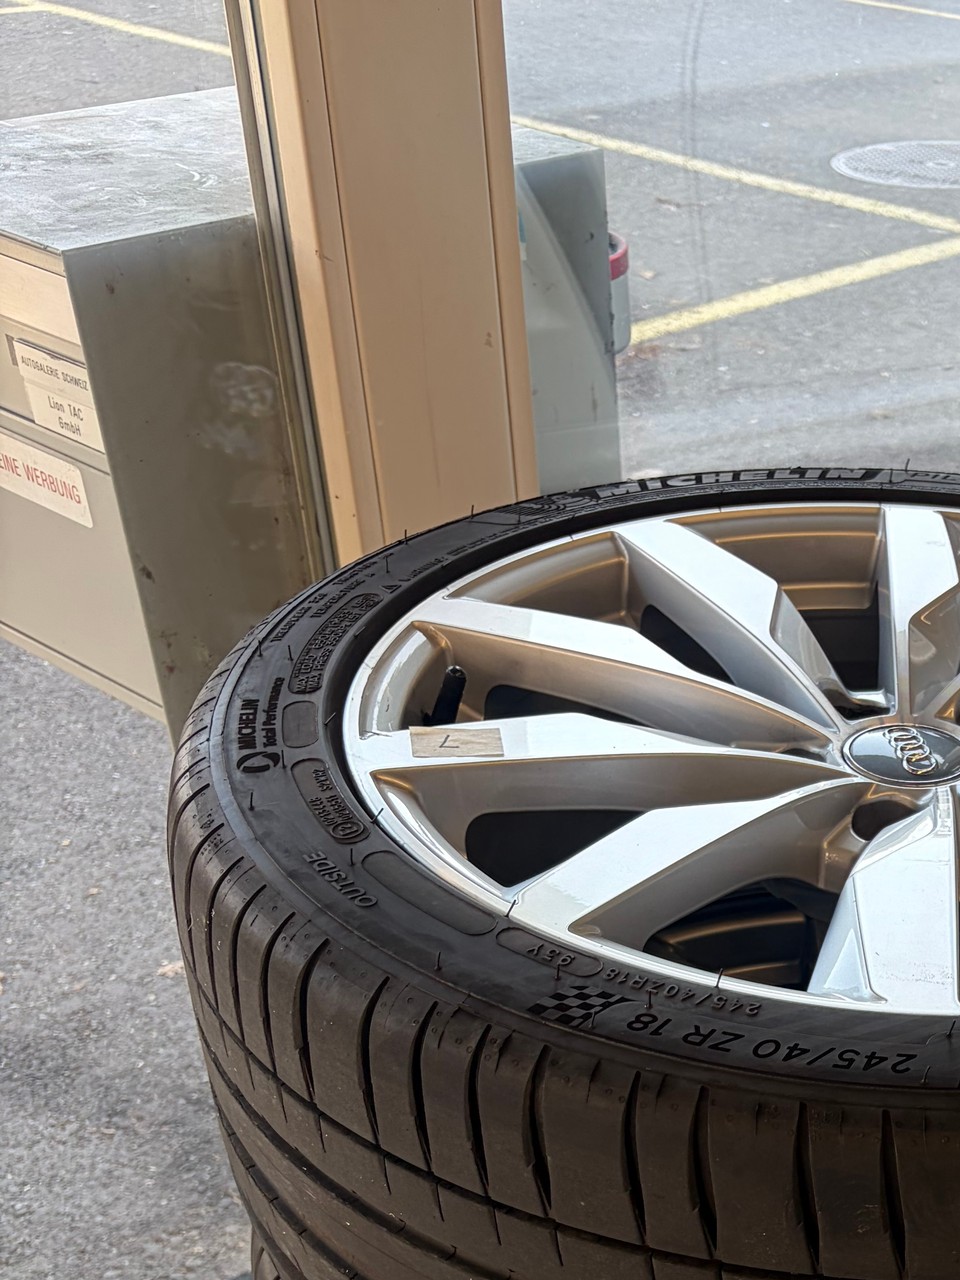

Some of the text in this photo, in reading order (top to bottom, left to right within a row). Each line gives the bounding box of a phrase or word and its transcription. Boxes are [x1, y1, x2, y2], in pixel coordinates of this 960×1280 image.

[48, 396, 84, 421] Lion TAC
[59, 418, 82, 436] GmbH
[22, 462, 82, 505] WERBUNG
[595, 467, 867, 496] MICHELIN
[238, 698, 260, 751] MICHELIN
[263, 676, 285, 750] Total Performance
[302, 850, 378, 907] OUTSIDE
[526, 941, 578, 967] 93Y
[603, 966, 763, 1016] 245/40ZR18
[626, 1012, 919, 1075] 245/40 ZR 18
